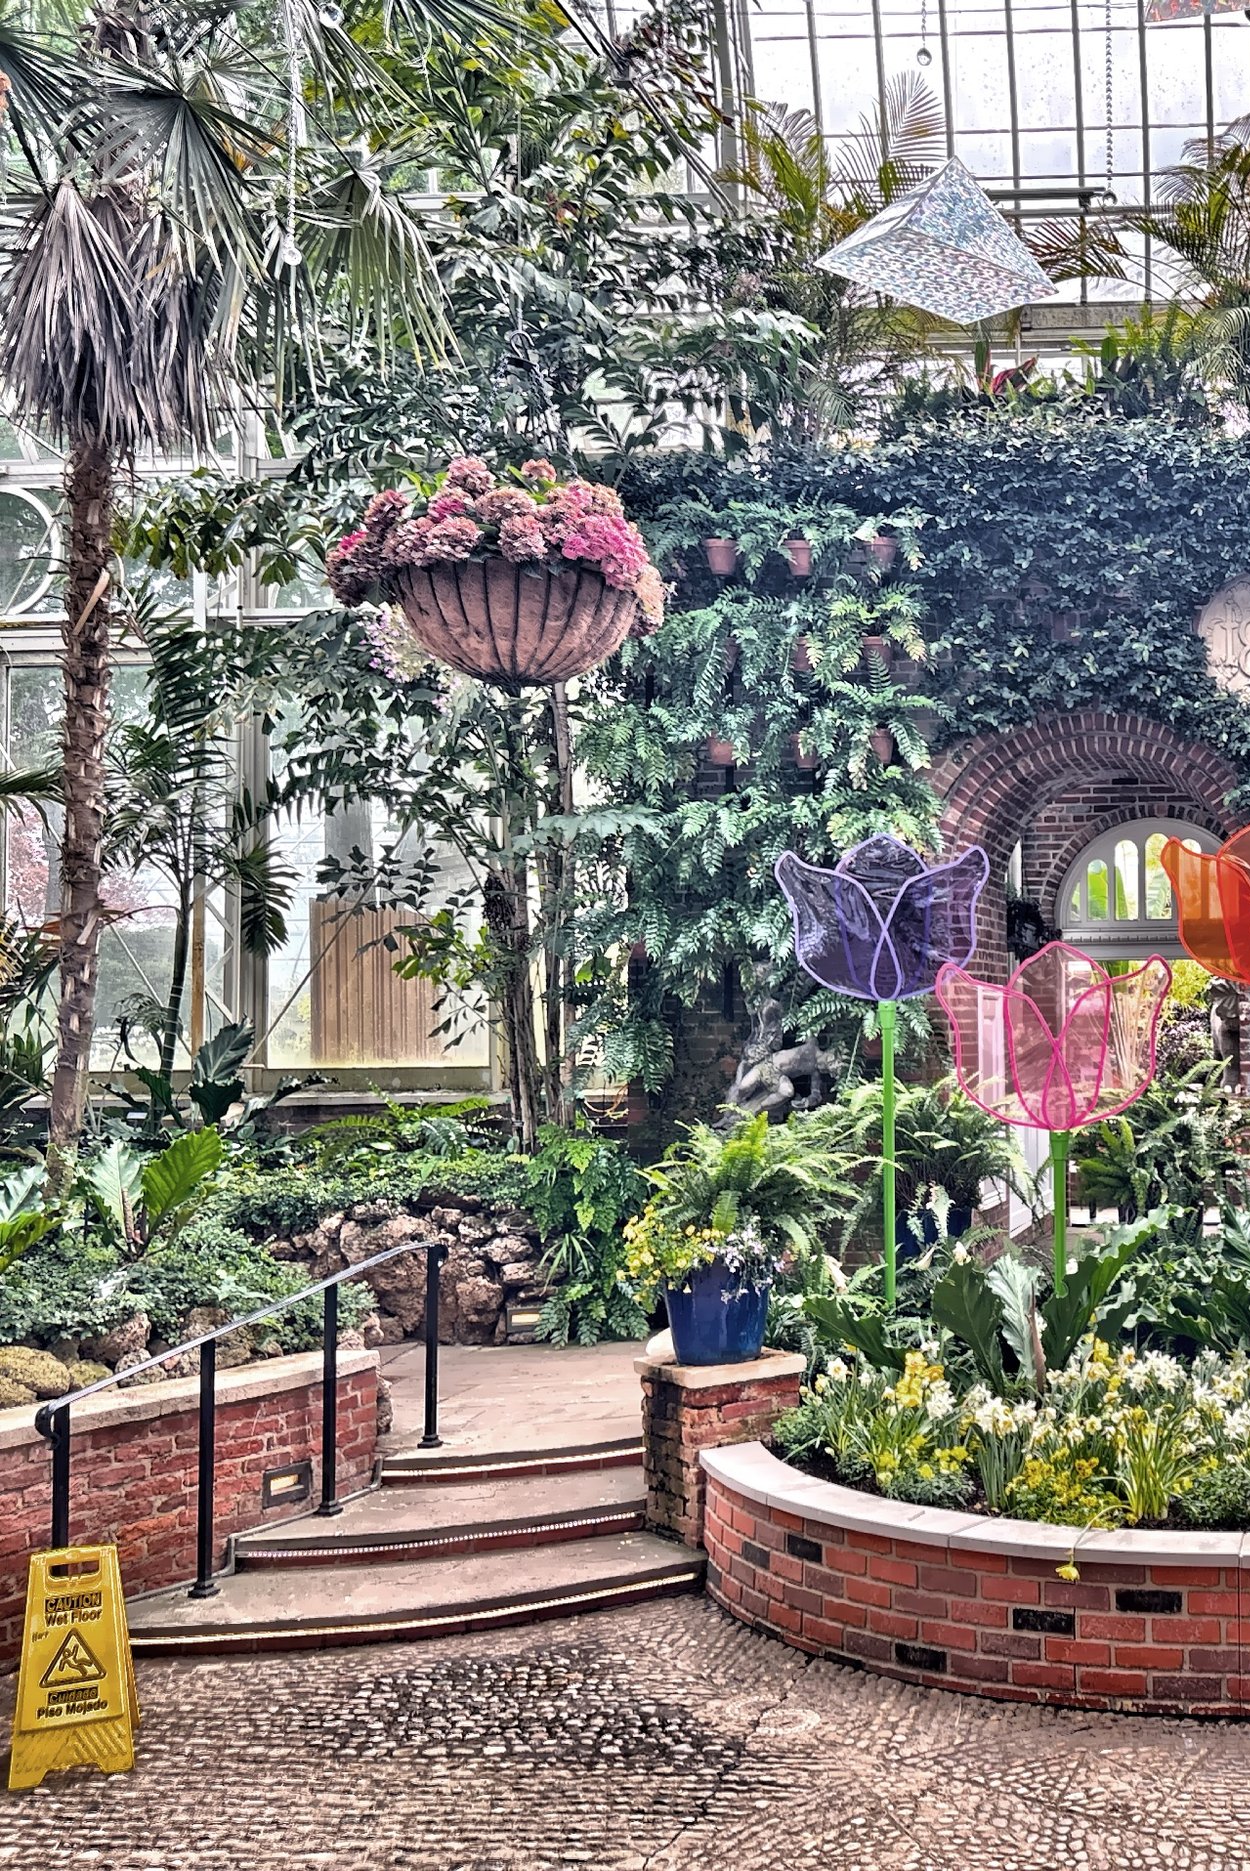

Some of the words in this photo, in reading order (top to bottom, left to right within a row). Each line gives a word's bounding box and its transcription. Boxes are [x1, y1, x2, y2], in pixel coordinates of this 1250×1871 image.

[46, 1592, 102, 1612] CAUTION
[45, 1612, 68, 1627] Wet
[70, 1609, 103, 1624] Floor
[49, 1687, 97, 1704] Cuidado
[37, 1706, 63, 1720] Piso
[65, 1698, 108, 1715] Mojado
